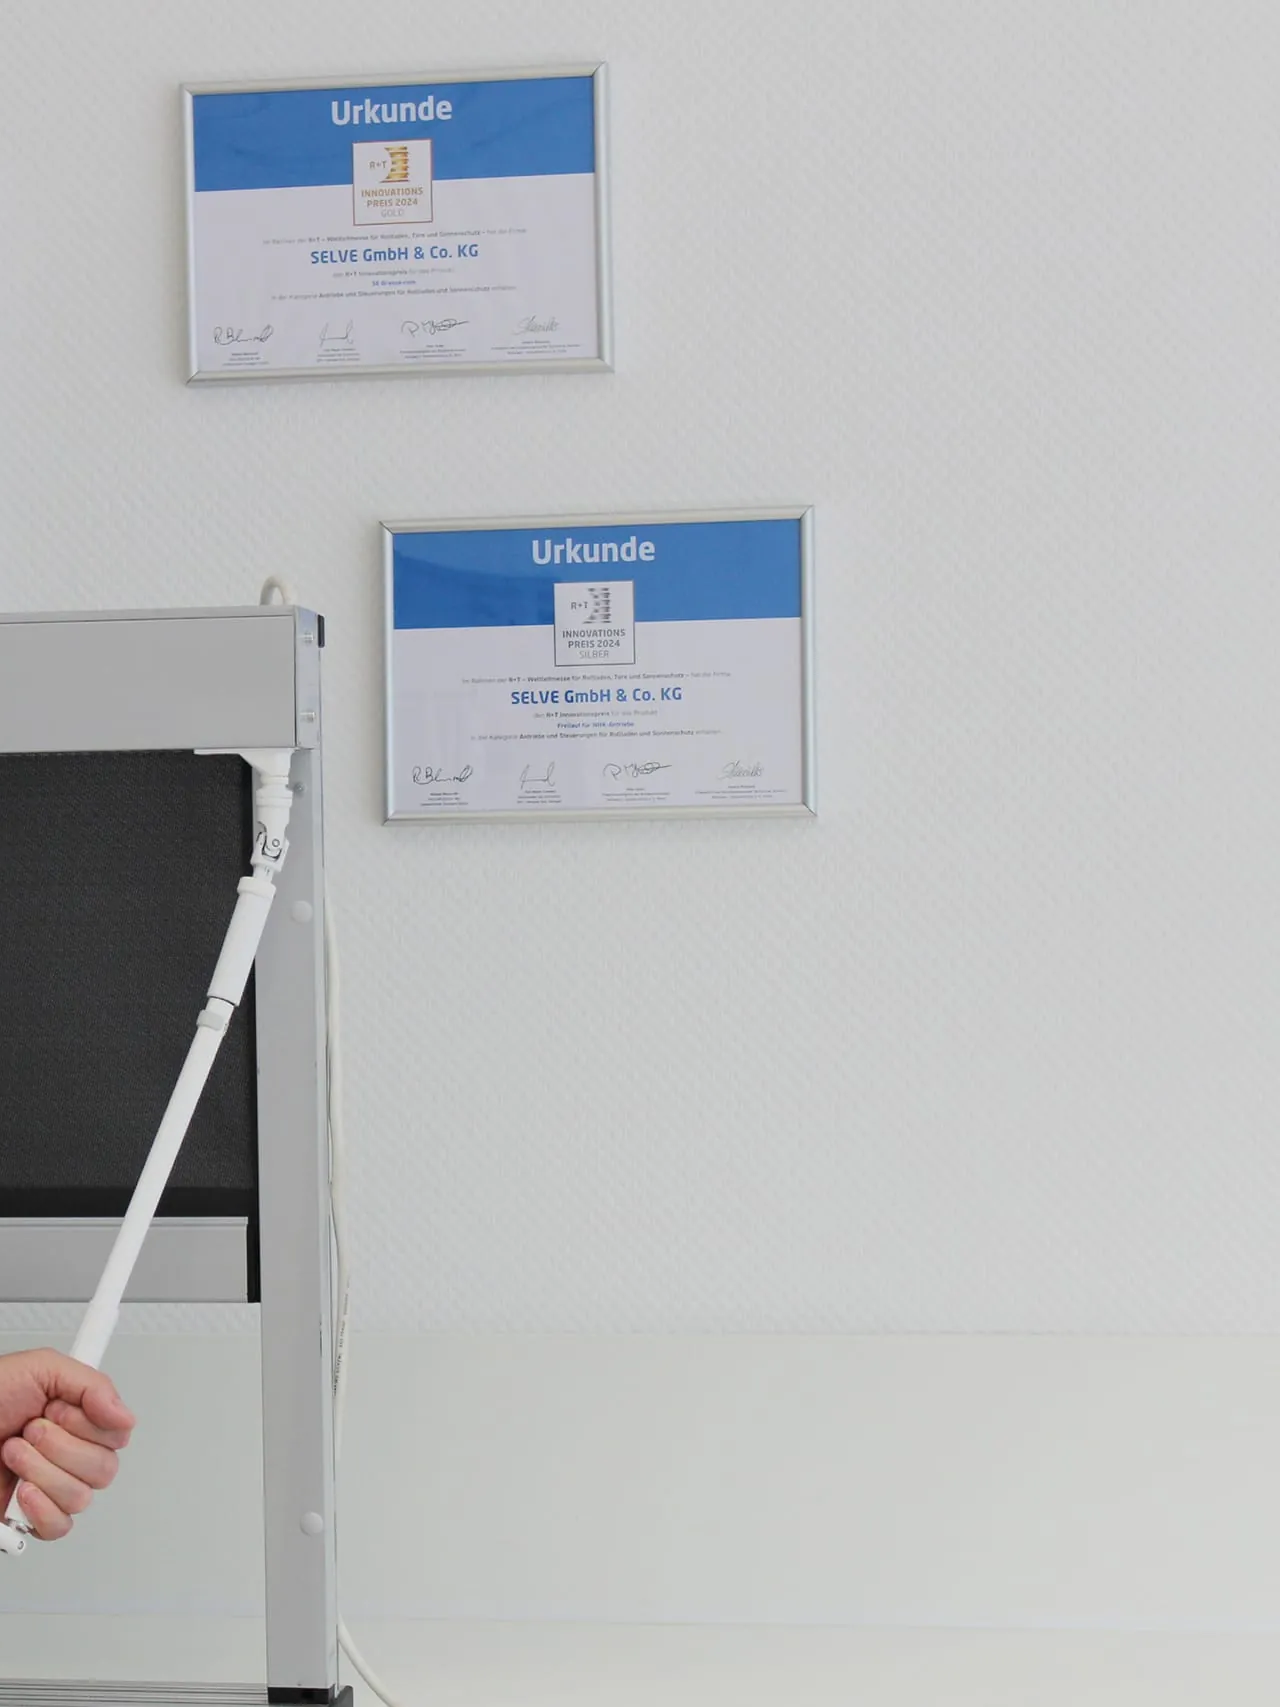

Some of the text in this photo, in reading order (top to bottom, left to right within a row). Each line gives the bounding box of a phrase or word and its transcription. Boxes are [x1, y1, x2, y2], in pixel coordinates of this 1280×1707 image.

[331, 95, 453, 126] Urkunde
[369, 160, 387, 170] R+T
[361, 187, 424, 198] INNOVATIONS
[367, 197, 418, 208] PREIS 2024
[381, 208, 404, 218] GOLD
[310, 244, 479, 264] SELVE GmbH & Co. KG
[532, 536, 656, 565] Urkunde
[570, 601, 588, 610] R+T
[562, 628, 626, 638] INNOVATIONS
[568, 639, 621, 648] PREIS 2024
[579, 650, 609, 659] SILBER
[511, 687, 682, 705] SELVE GmbH & Co. KG
